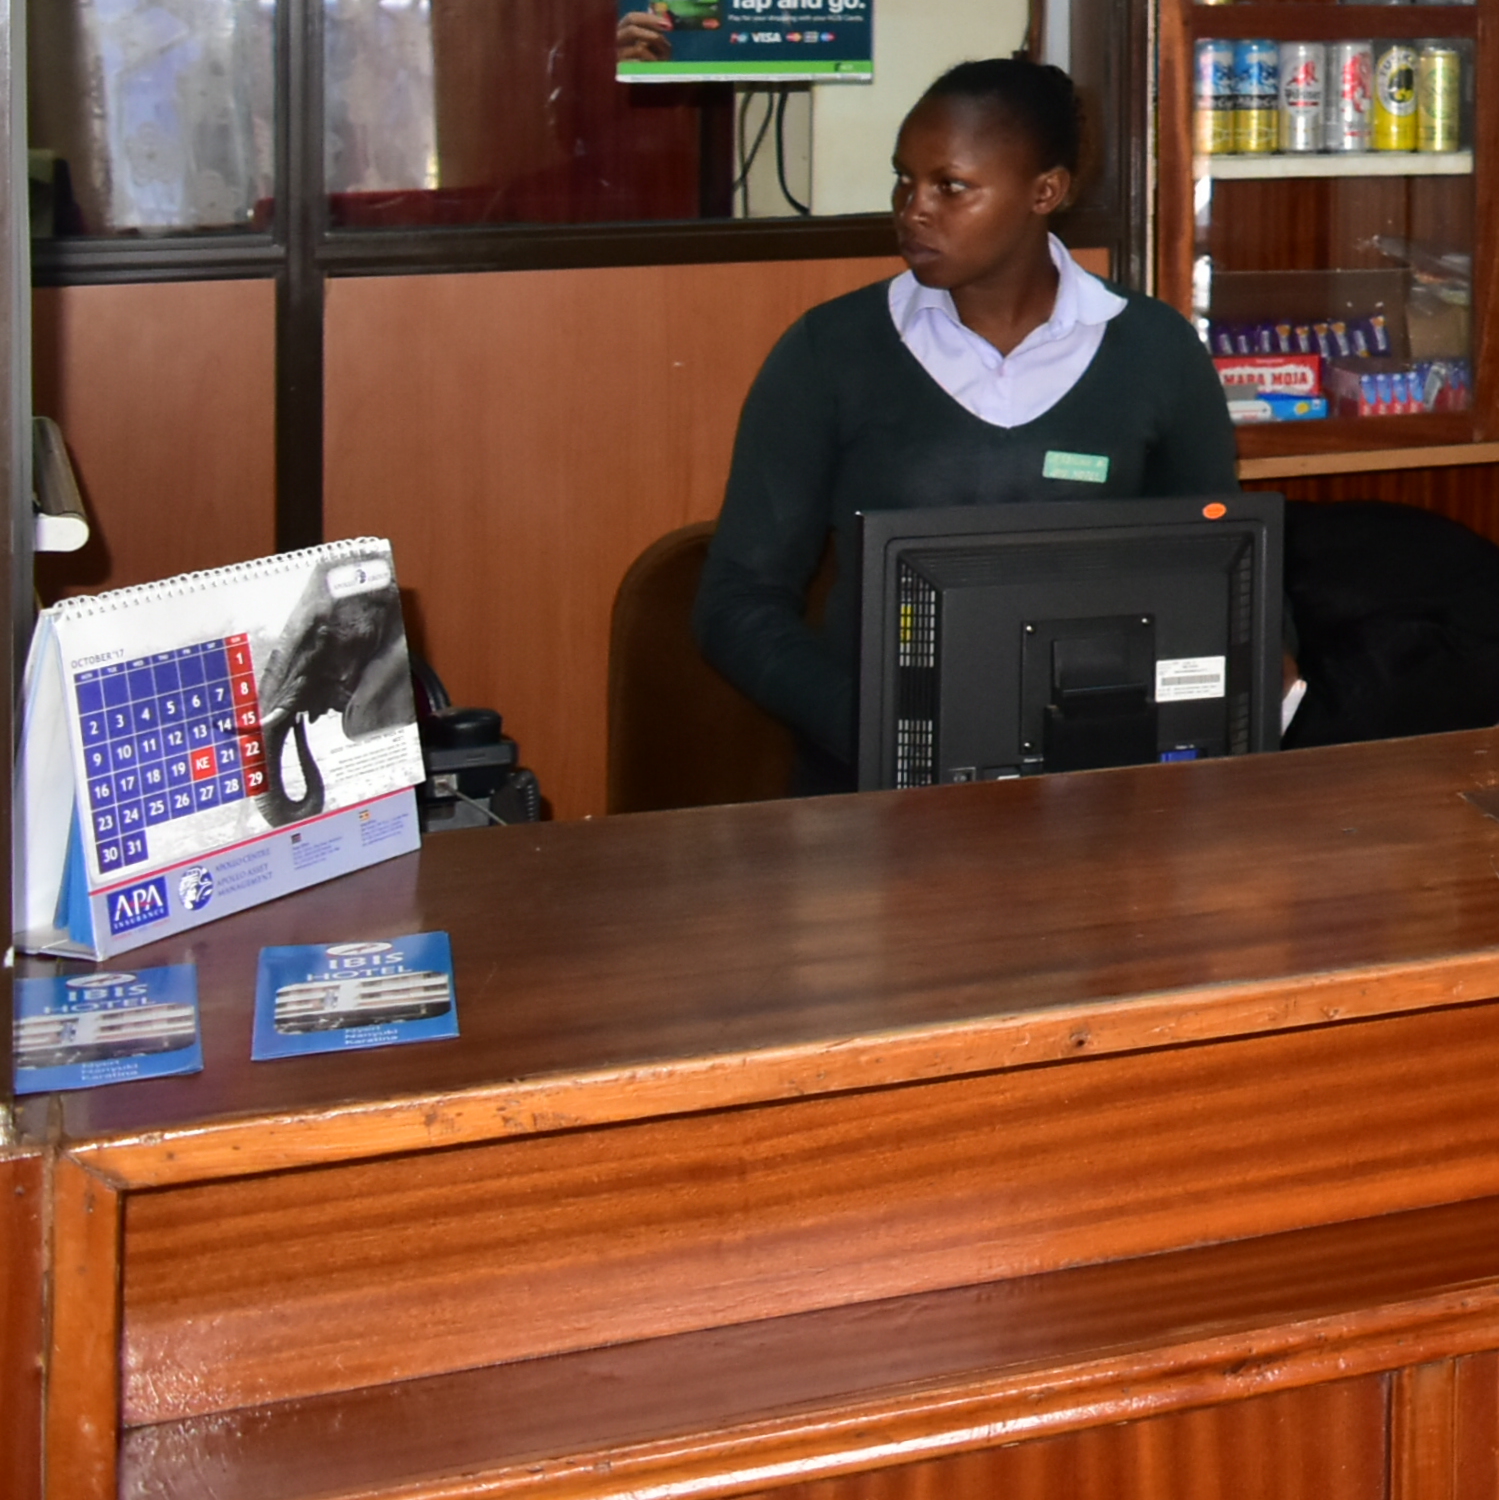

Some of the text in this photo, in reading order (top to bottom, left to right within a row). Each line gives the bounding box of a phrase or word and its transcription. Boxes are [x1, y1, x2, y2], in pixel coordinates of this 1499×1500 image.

[751, 32, 782, 43] VISA
[1272, 372, 1308, 386] MOJA
[71, 653, 112, 669] OCTOBER
[237, 653, 243, 664] 1
[90, 682, 248, 735] 2 3 4 5 6 7 8
[93, 713, 256, 766] 9 10 11 12 13 14 15
[95, 742, 259, 798] 16 17 18 19 KE 21 22
[99, 772, 263, 831] 23 24 25 26 27 28 29
[103, 840, 141, 862] 30 31
[114, 885, 163, 921] APA
[113, 908, 164, 930] INSURANCE
[329, 952, 404, 970] IBIS
[307, 965, 412, 982] HOTEL
[68, 983, 148, 1002] IBIS
[43, 997, 156, 1014] HOTEL
